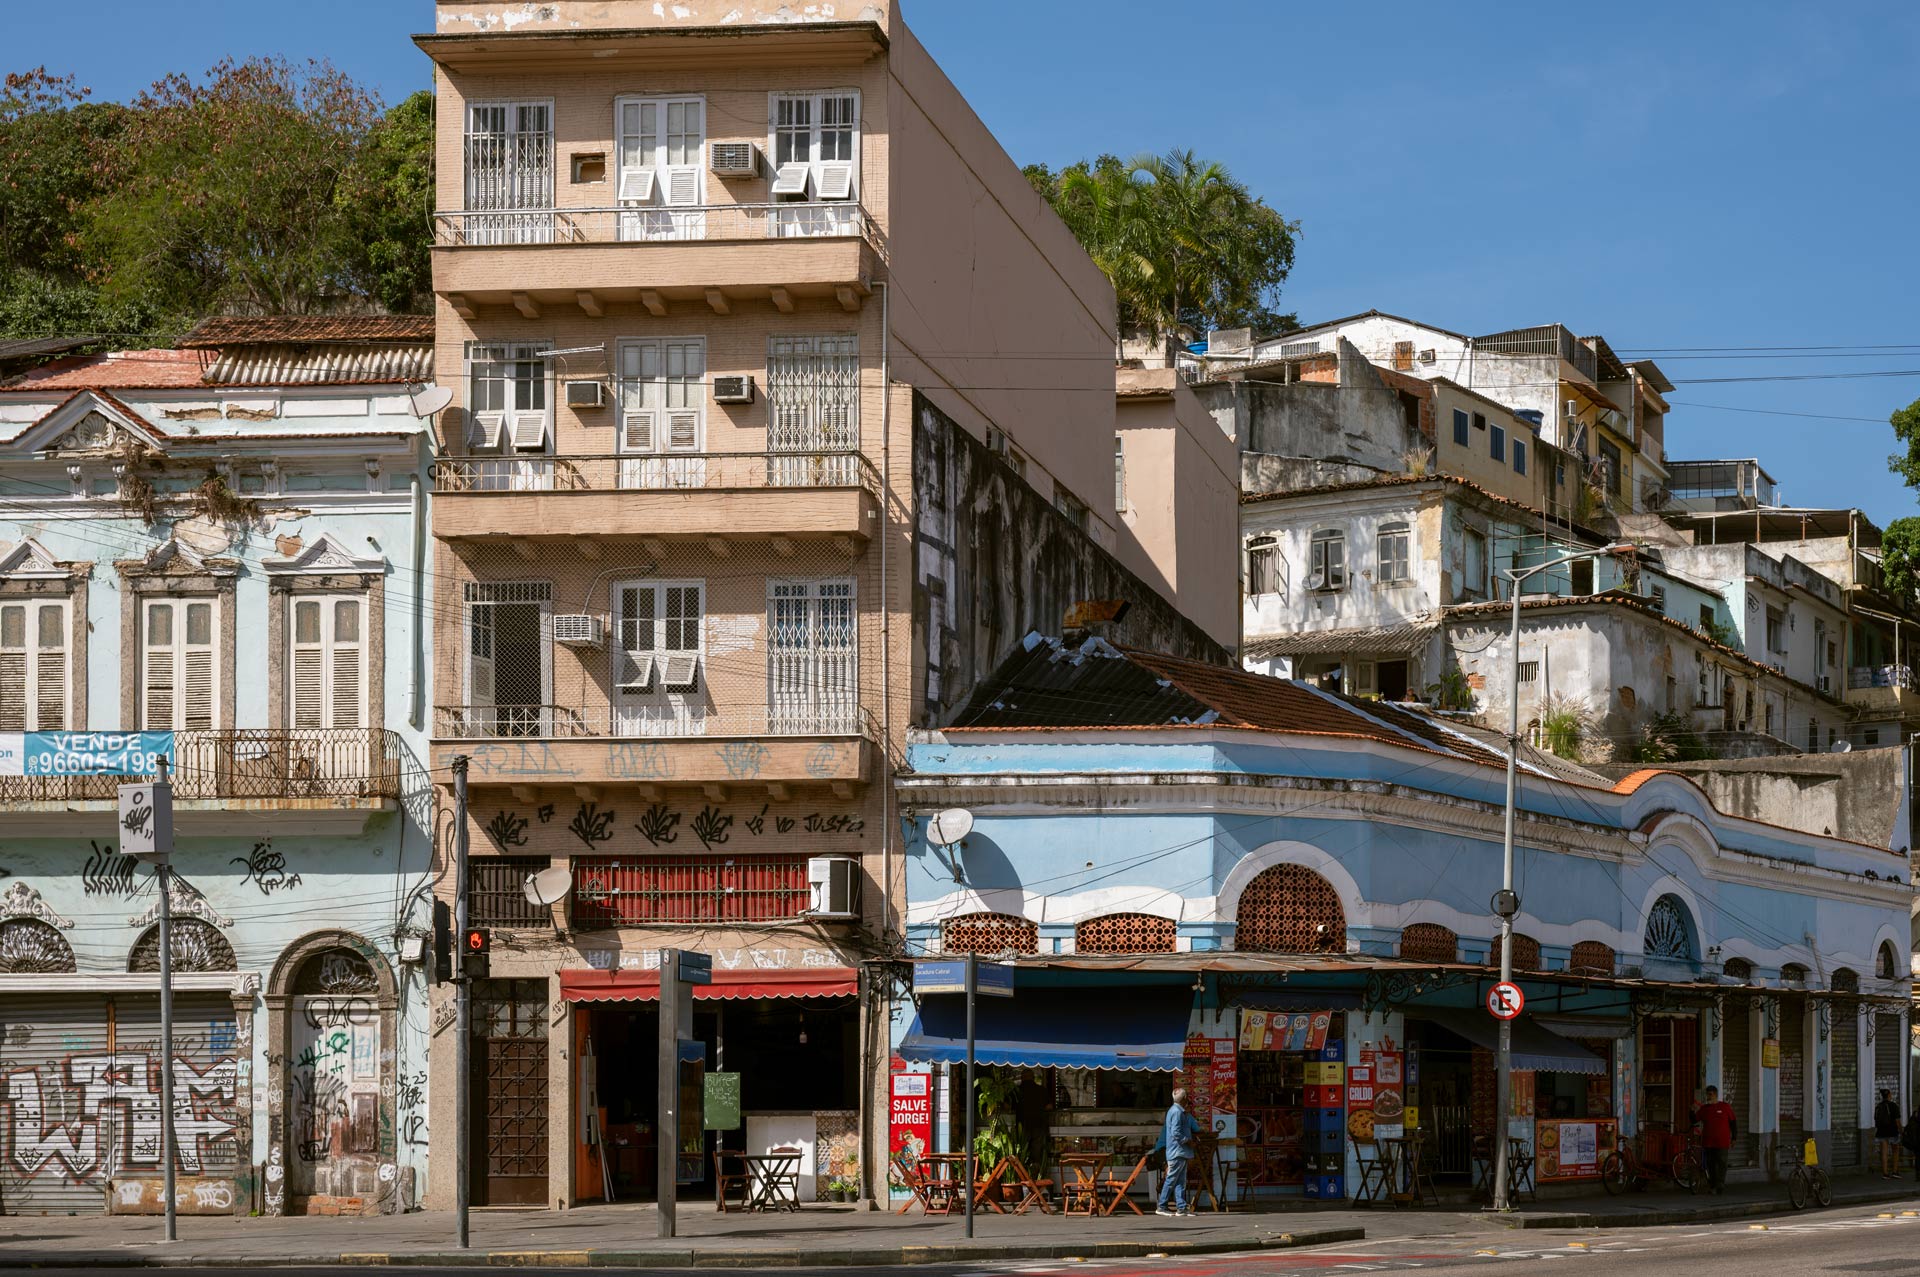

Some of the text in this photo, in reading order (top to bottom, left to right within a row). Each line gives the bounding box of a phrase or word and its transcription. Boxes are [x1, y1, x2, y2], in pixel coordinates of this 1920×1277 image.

[53, 732, 142, 751] VENDE
[39, 751, 170, 774] 96605-198
[1498, 990, 1511, 1011] E
[1349, 1087, 1373, 1101] CALDO
[893, 1099, 928, 1112] SALVE
[890, 1112, 929, 1125] JORGE!
